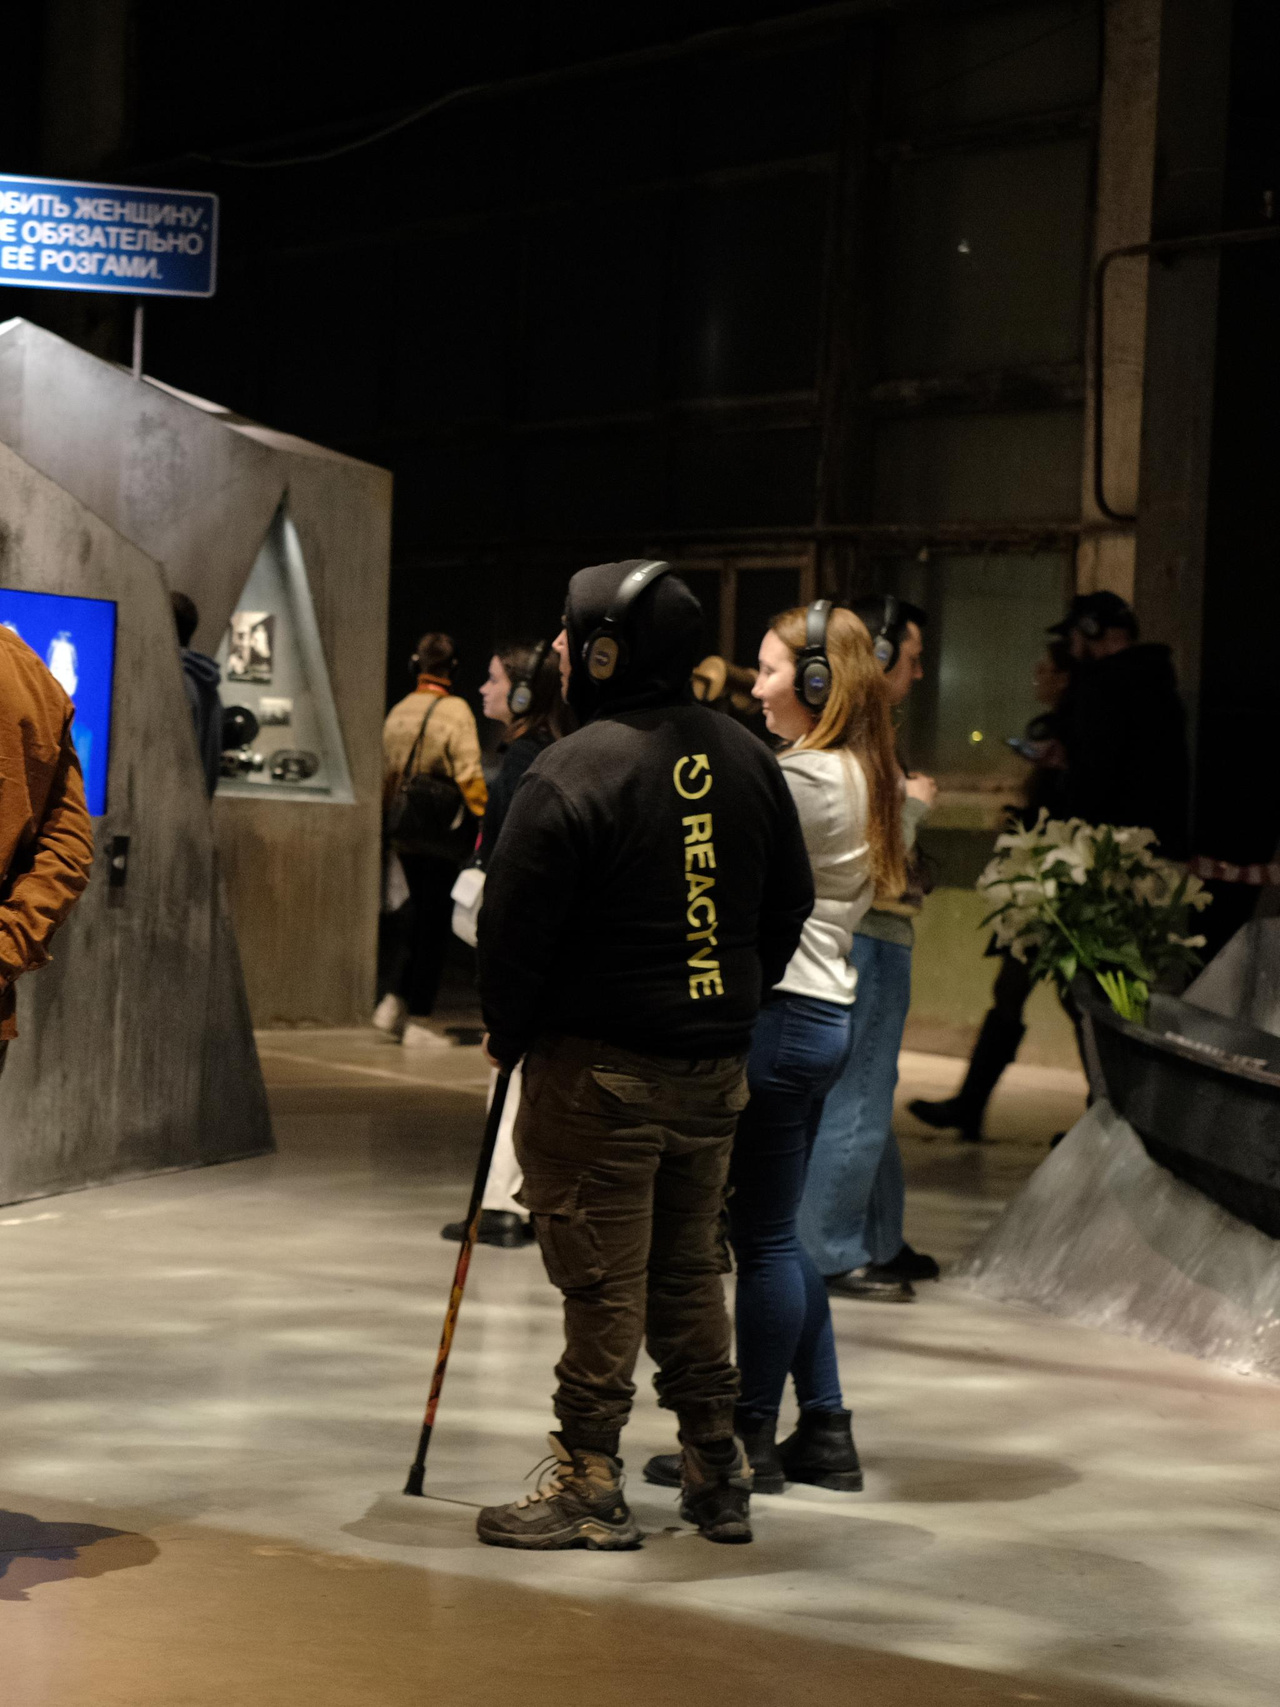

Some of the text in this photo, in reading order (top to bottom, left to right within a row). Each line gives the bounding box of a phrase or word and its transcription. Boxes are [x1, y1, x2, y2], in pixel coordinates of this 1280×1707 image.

[21, 220, 203, 255] ОБЯЗАТЕЛЬНО
[1, 244, 35, 271] ЕЁ
[40, 249, 163, 279] РОЗГАМИ.
